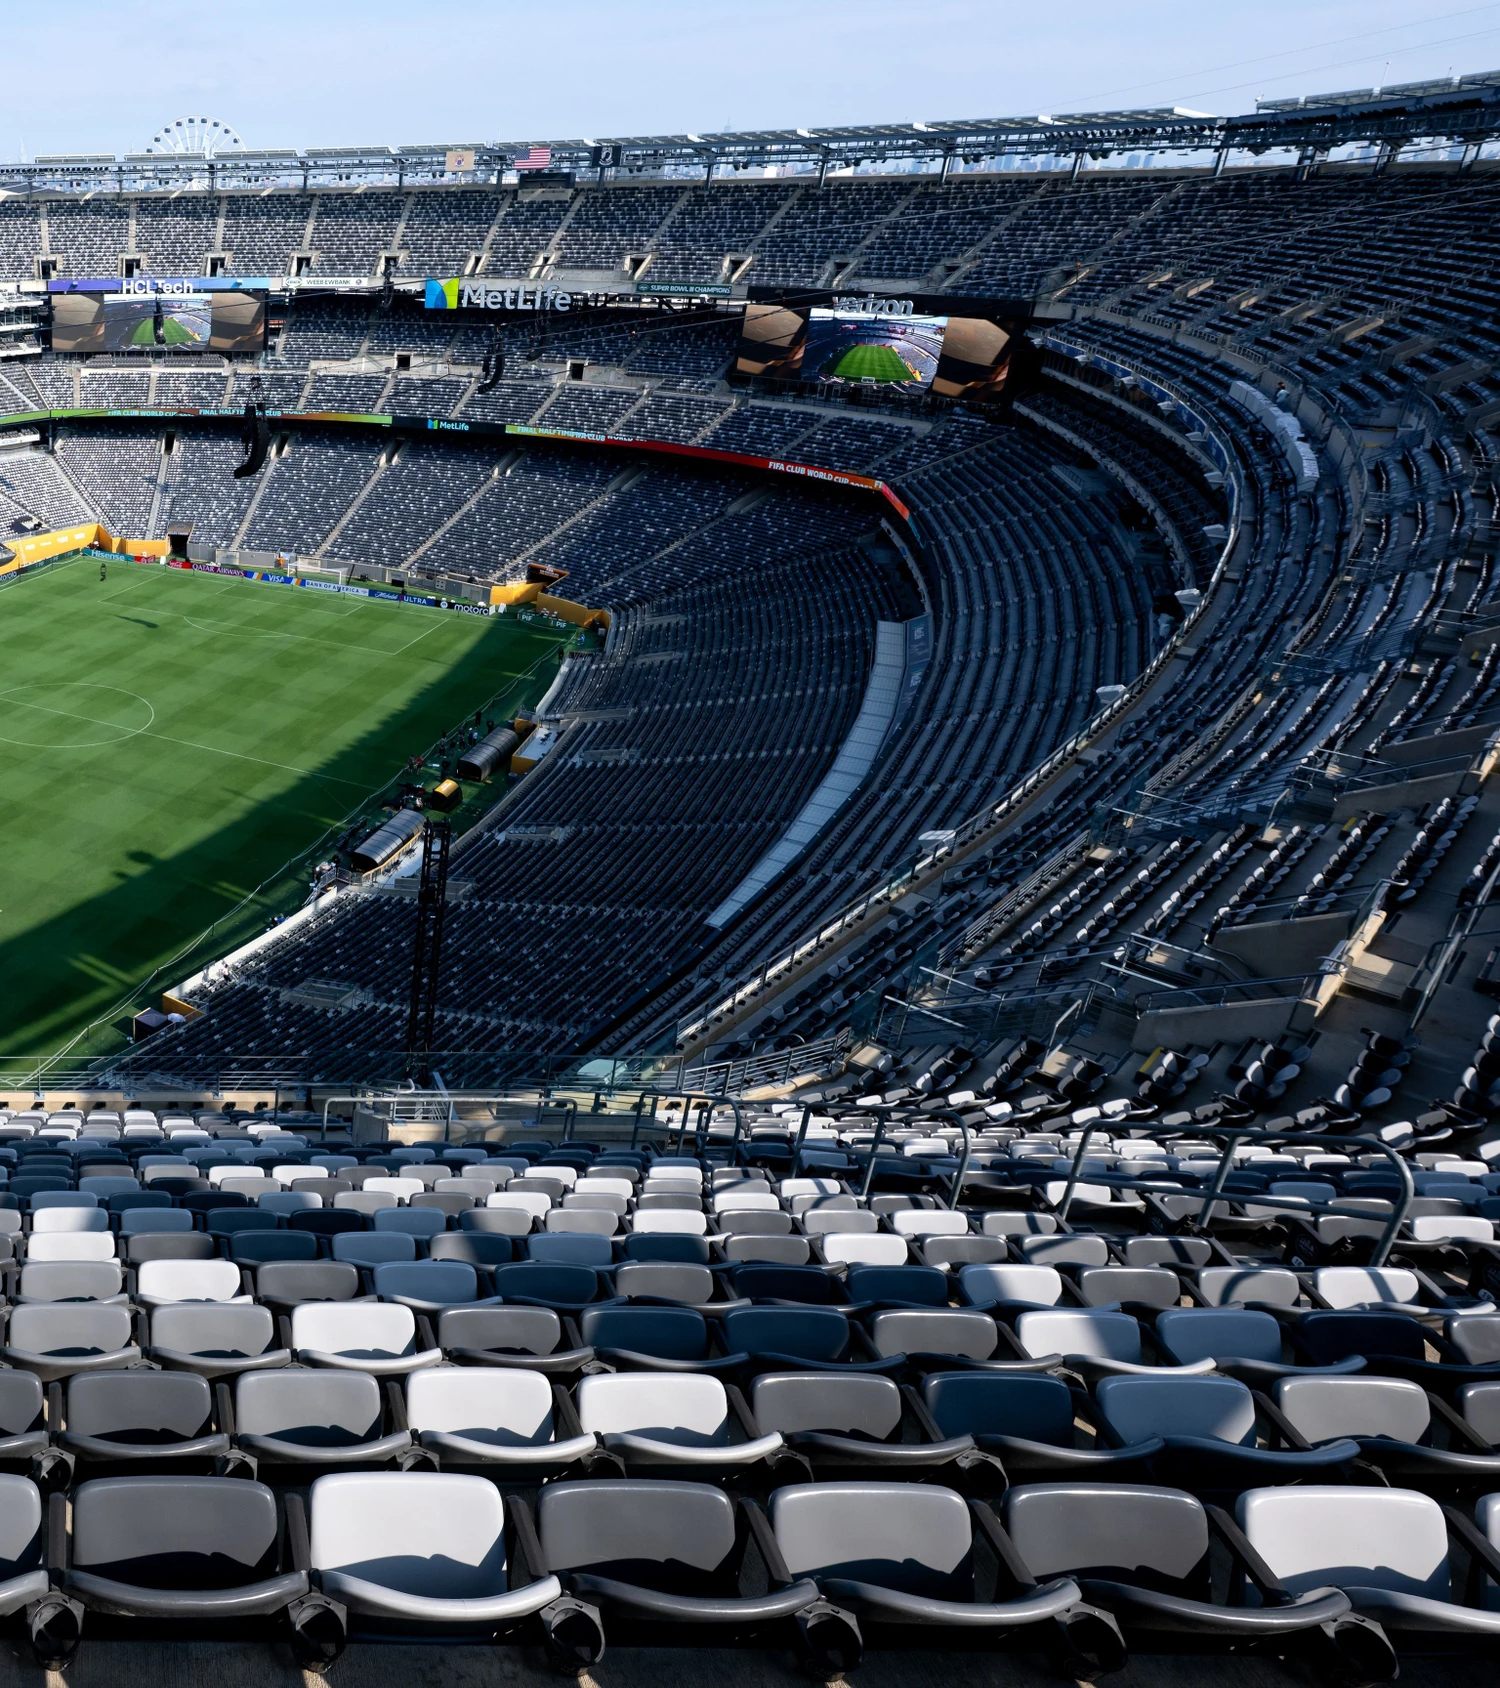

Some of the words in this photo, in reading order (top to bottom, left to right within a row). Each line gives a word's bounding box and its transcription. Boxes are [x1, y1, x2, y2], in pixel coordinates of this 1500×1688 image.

[122, 280, 194, 294] HCLTech
[650, 284, 669, 292] SUPER
[670, 285, 688, 293] BOWL
[695, 286, 731, 294] CHAMPIONS
[462, 284, 572, 311] MetLife
[832, 293, 914, 316] verizon
[439, 421, 469, 431] MetLife
[517, 426, 537, 434] FINAL
[768, 461, 785, 471] FIFA
[786, 464, 805, 475] CLUB
[807, 469, 833, 481] WORLD
[833, 476, 849, 485] CUP
[91, 550, 125, 561] Hisense
[192, 563, 214, 572] QATAR
[217, 567, 245, 577] AIRWAYS
[268, 574, 285, 582] VISA
[332, 585, 359, 593] AMERICA
[403, 595, 427, 605] ULTRA
[454, 604, 489, 616] motoro
[521, 614, 532, 622] PIF
[555, 621, 567, 629] PIF
